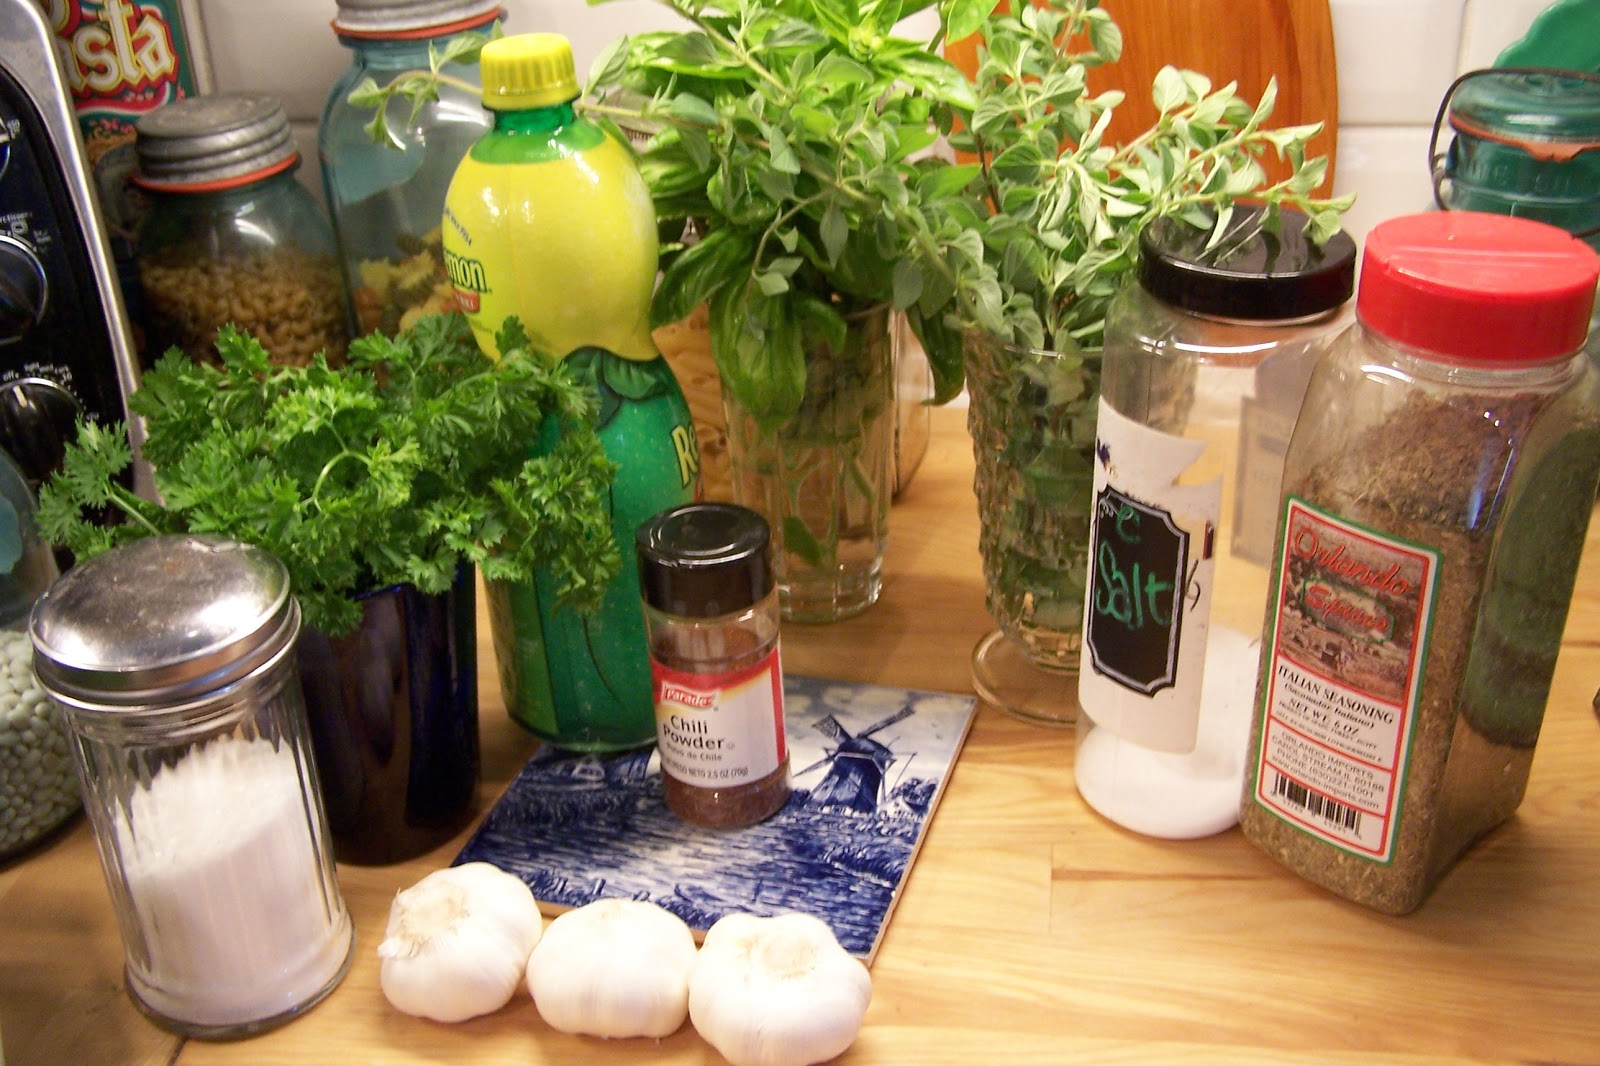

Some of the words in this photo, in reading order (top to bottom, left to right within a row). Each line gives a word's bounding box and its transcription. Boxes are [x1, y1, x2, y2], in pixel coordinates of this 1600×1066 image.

[1294, 527, 1409, 597] Orlando
[1097, 540, 1174, 631] Salt
[665, 687, 709, 707] Parade
[1278, 665, 1321, 695] ITALIAN
[1324, 688, 1395, 725] SEASONING
[670, 714, 708, 734] Chili
[1289, 698, 1308, 714] NET
[1334, 720, 1341, 731] 6
[1343, 723, 1360, 735] OZ
[663, 723, 725, 750] Powder
[700, 750, 722, 762] Chile
[1272, 735, 1298, 757] CAROL
[1302, 753, 1341, 777] STREAM
[1276, 747, 1309, 770] PHONE
[1281, 731, 1326, 759] ORLANDO
[1328, 753, 1375, 780] IMPORTS
